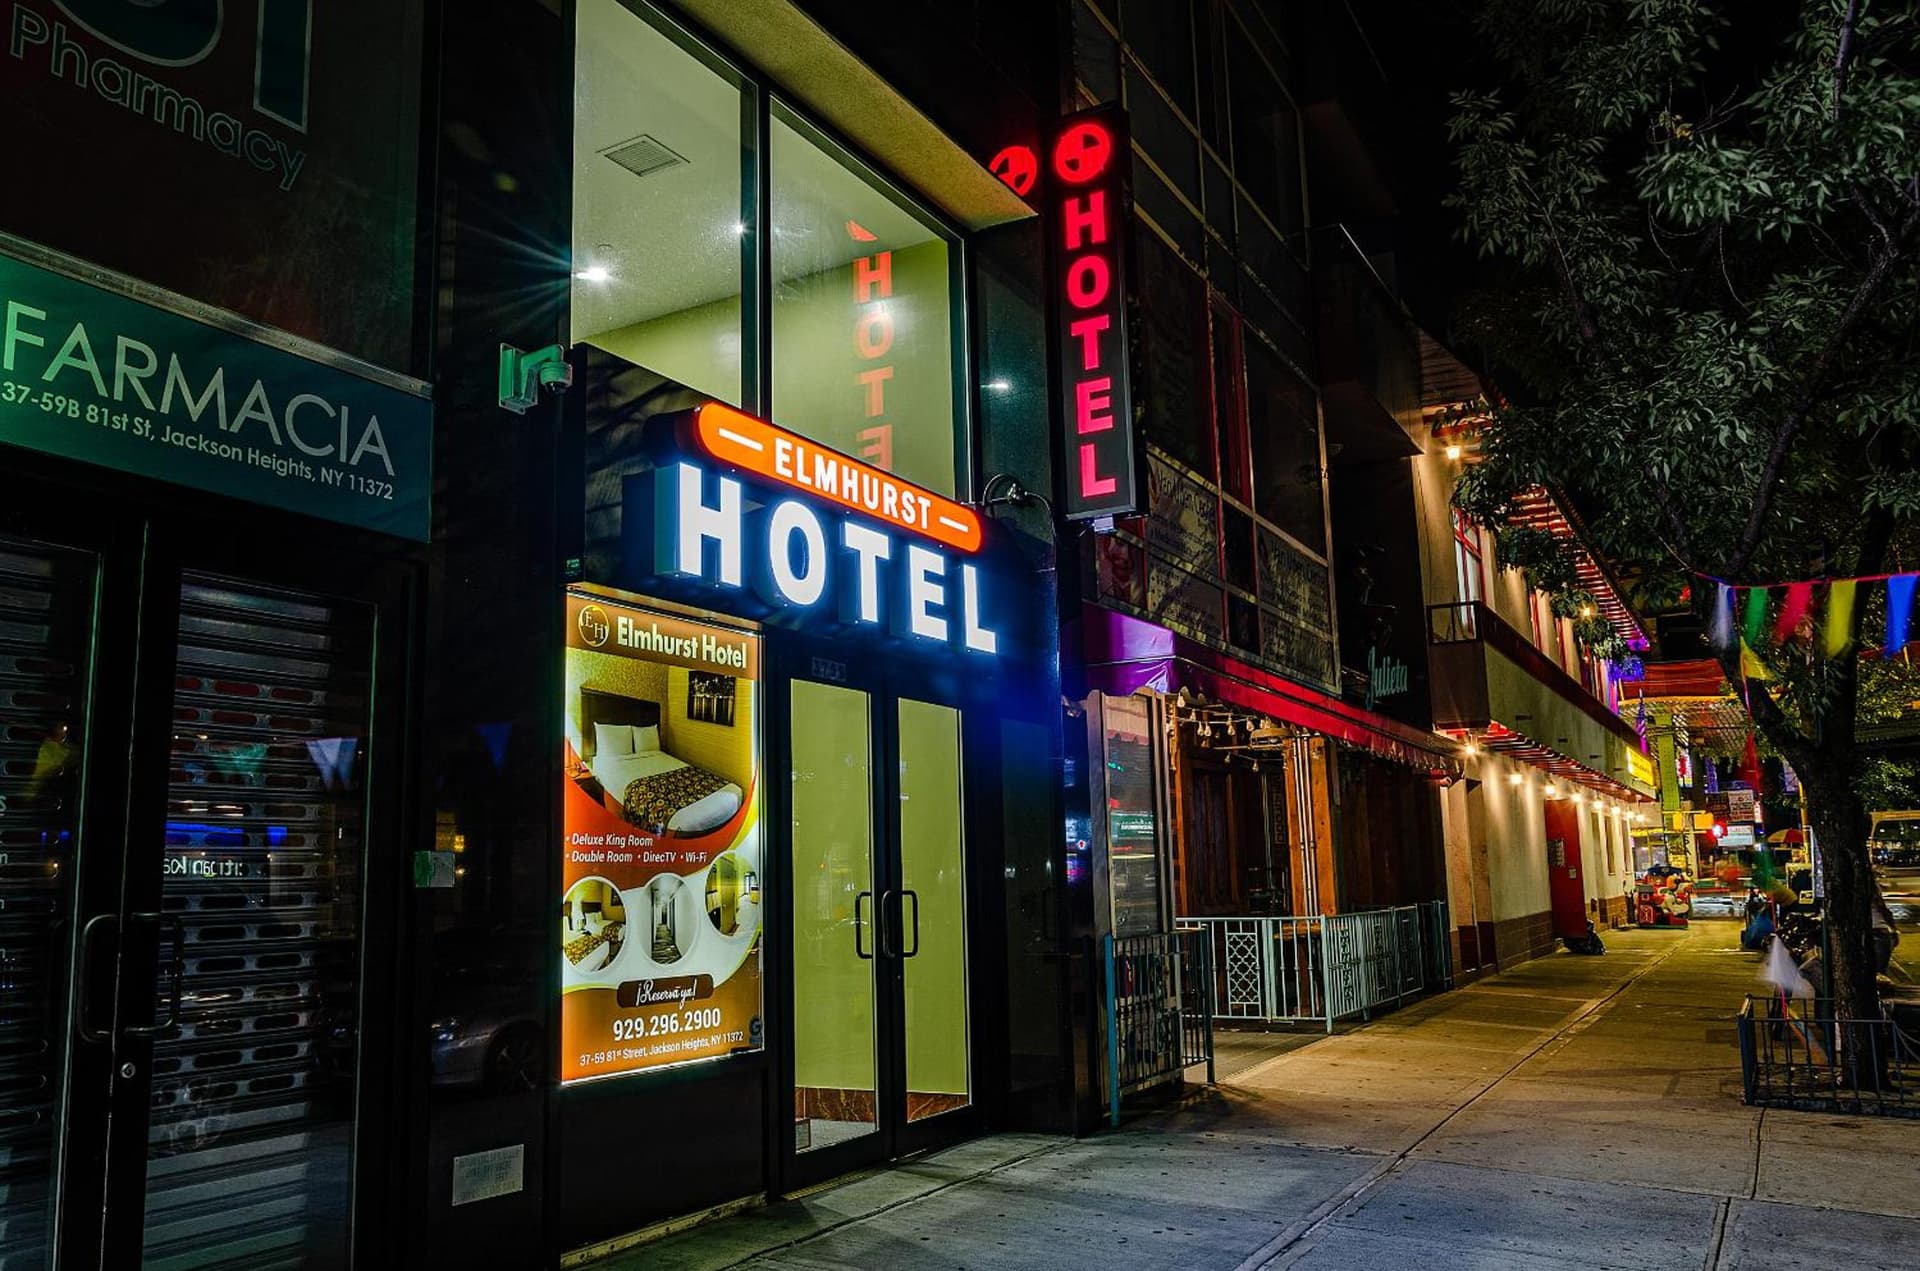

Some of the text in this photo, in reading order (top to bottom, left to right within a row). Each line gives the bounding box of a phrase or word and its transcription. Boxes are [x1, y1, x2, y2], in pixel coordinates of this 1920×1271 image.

[9, 3, 306, 192] Pharmacy
[2, 300, 396, 477] FARMACIA
[1064, 190, 1117, 498] HOTEL
[2, 381, 393, 500] 37-59B 81st St, Jackson Heights, NY 11372
[775, 437, 931, 529] ELMHURST
[678, 461, 996, 654] HOTEL
[617, 615, 747, 669] Elmhurst Hotel
[572, 833, 653, 849] Deluxe King Room
[572, 850, 708, 863] Double Room DirecTV Wi-Fi
[613, 1007, 721, 1041] 929.296.2900
[649, 1041, 681, 1056] Jackson
